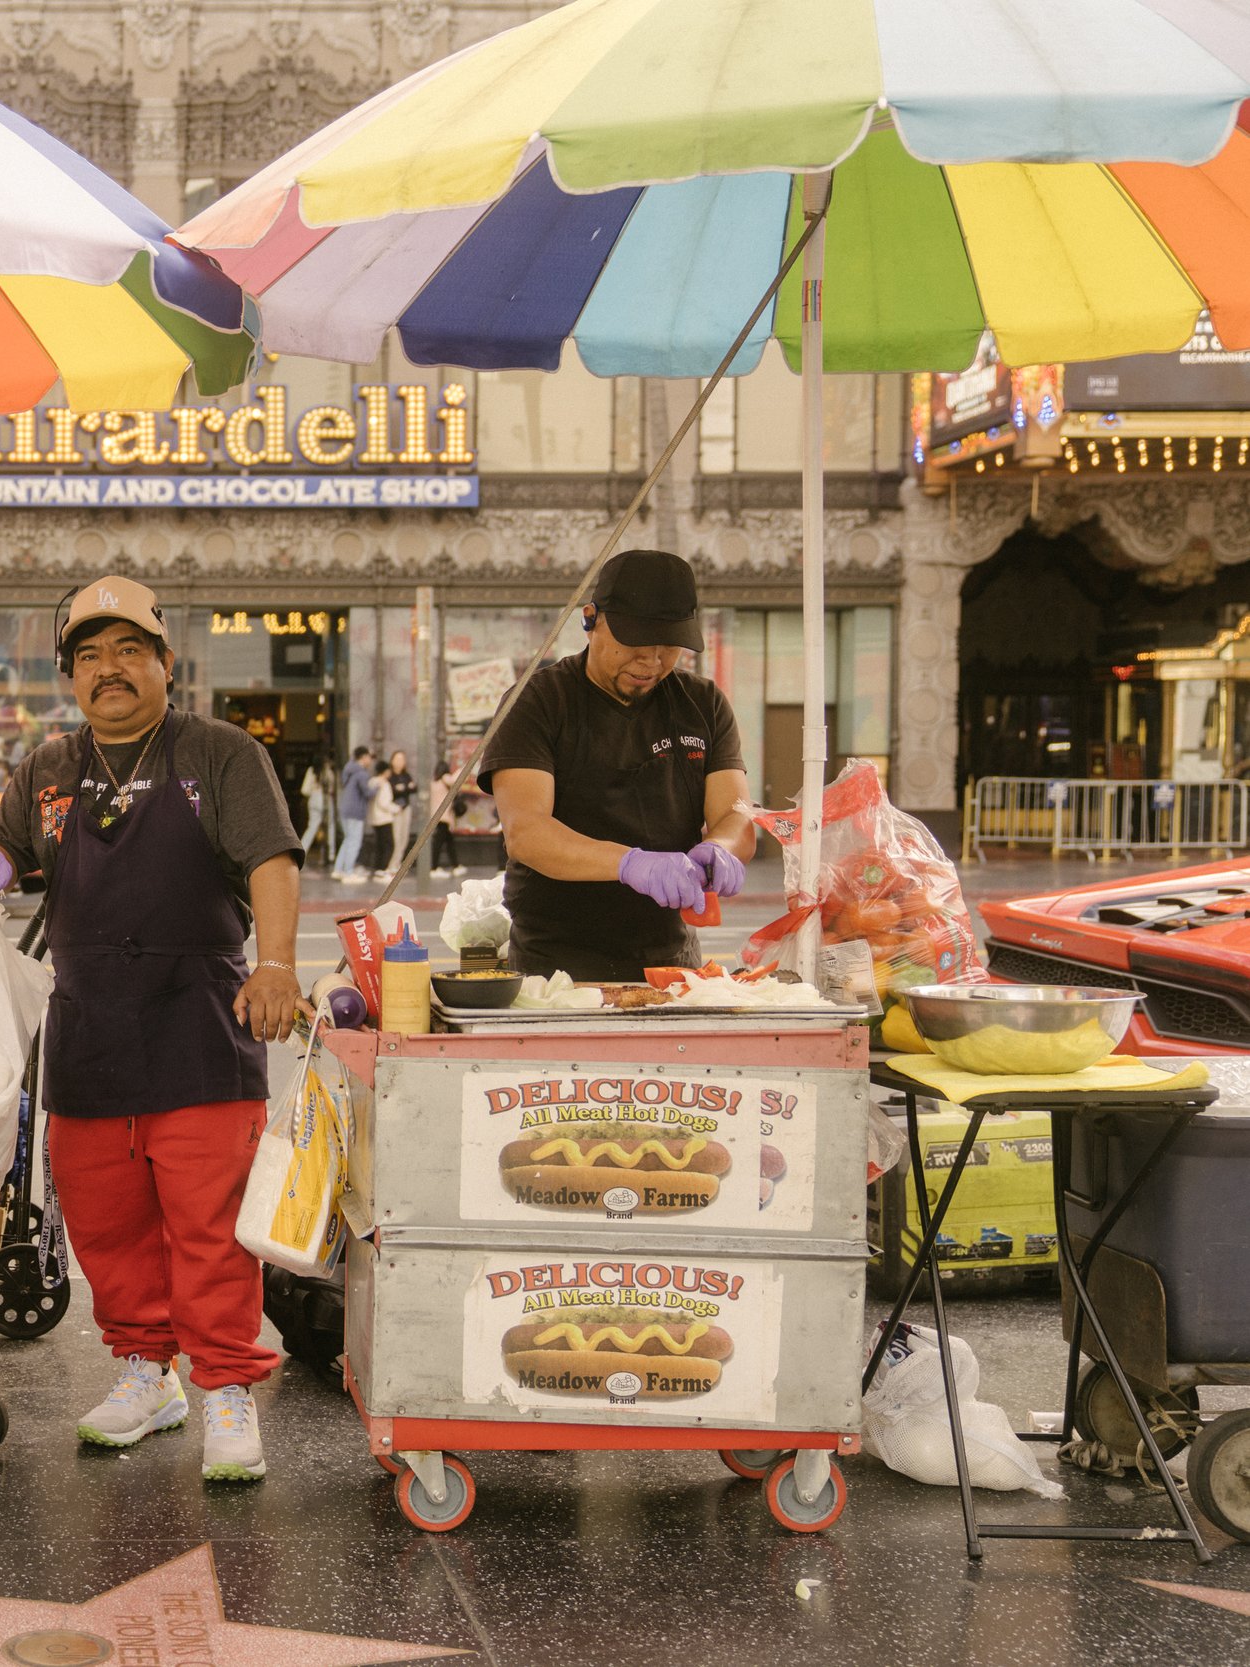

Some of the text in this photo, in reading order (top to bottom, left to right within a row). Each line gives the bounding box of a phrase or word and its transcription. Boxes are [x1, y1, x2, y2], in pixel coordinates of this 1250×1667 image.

[103, 478, 175, 504] AND
[178, 477, 378, 504] CHOCOLATE
[379, 477, 472, 504] SHOP
[352, 919, 373, 961] Daisy
[484, 1078, 743, 1116] DELICIOUS!
[519, 1104, 718, 1133] All Meat Hot Dogs
[514, 1185, 710, 1208] Meadow Farms
[606, 1210, 633, 1220] Brand
[486, 1262, 744, 1300] DELICIOUS!
[522, 1289, 720, 1318] All Meat Hot Dogs
[517, 1369, 712, 1393] Meadow Farms
[608, 1395, 636, 1405] Brand
[113, 1615, 161, 1667] PIONEE
